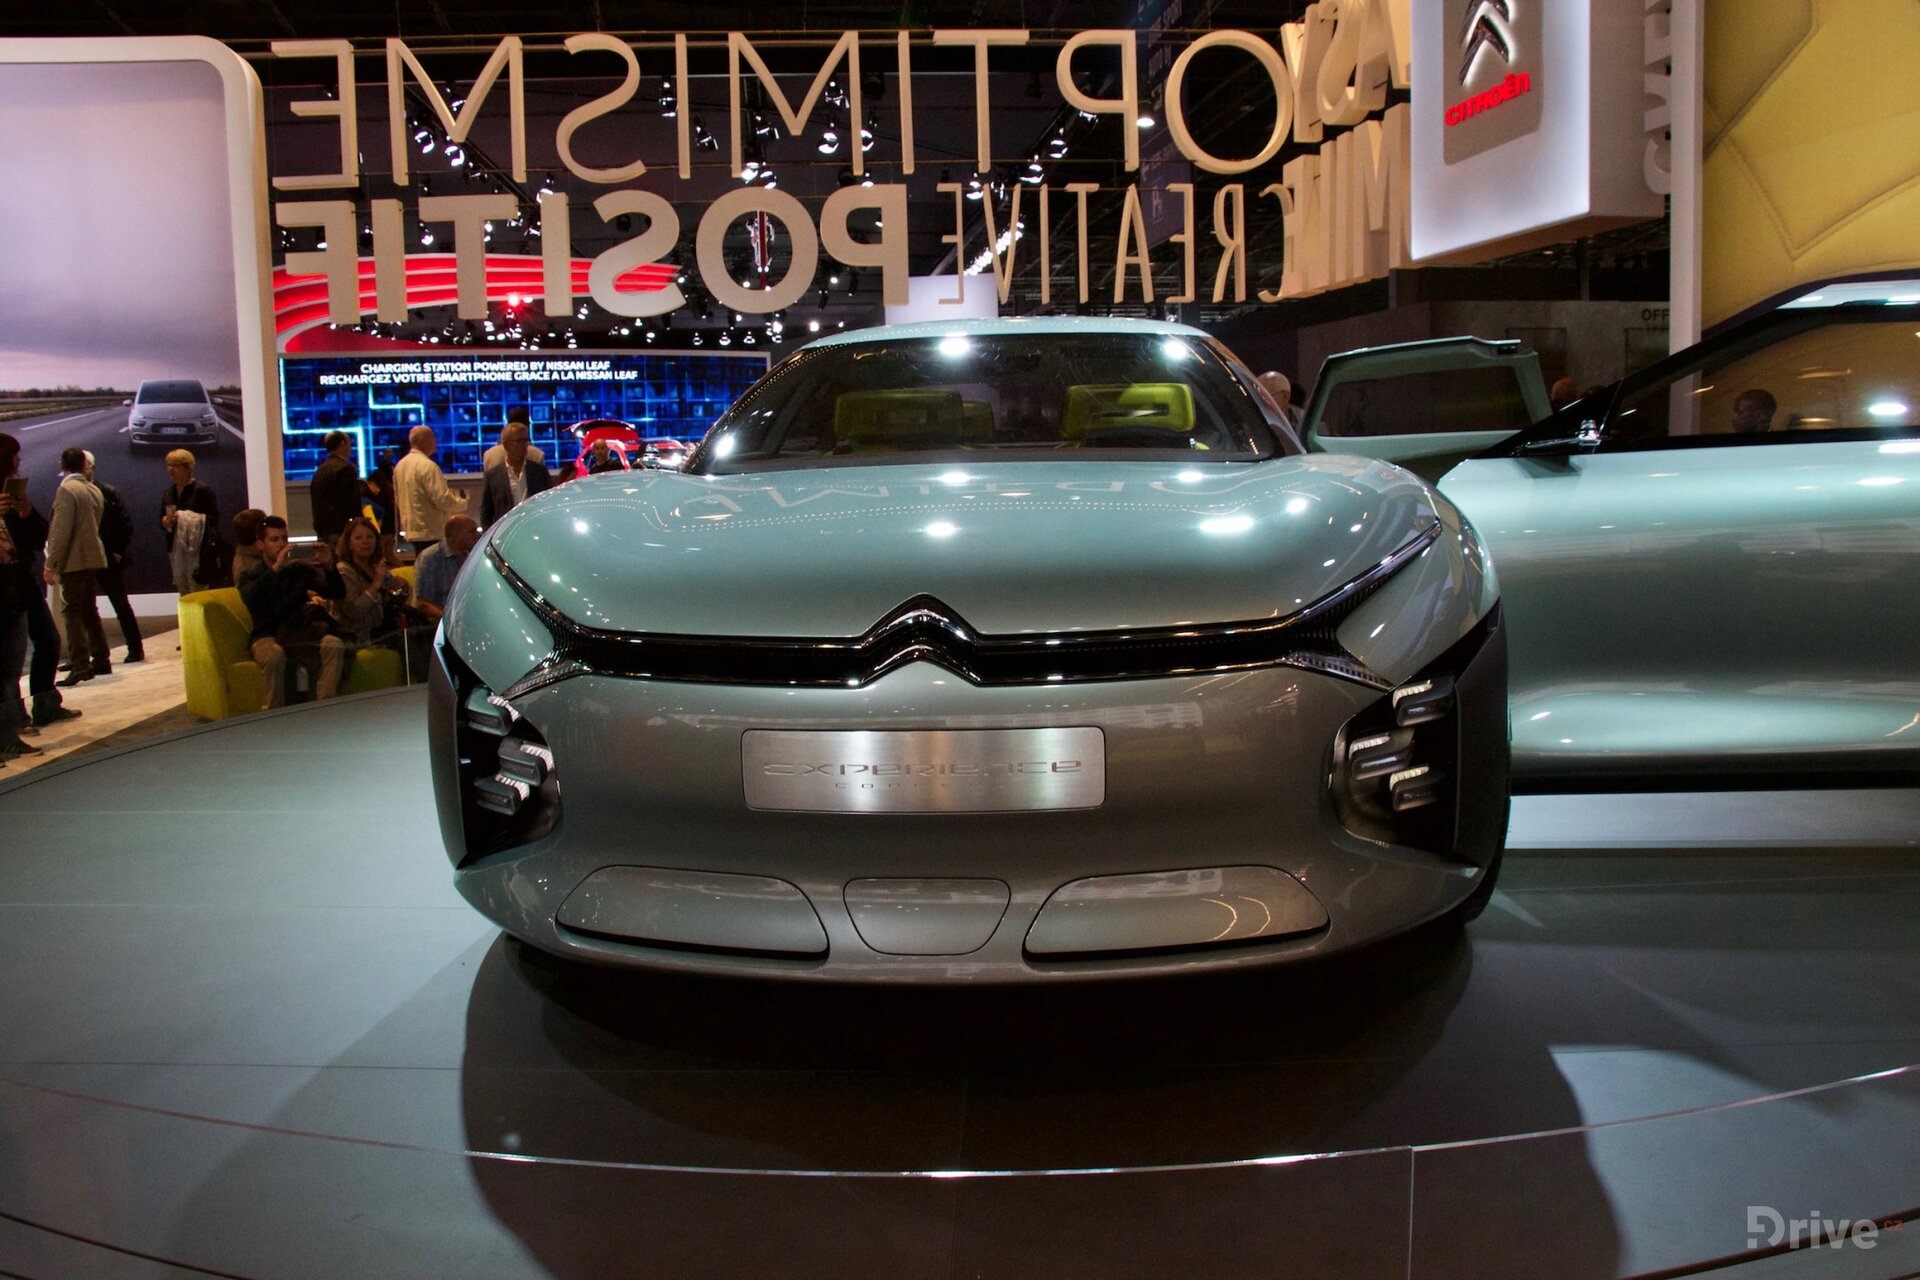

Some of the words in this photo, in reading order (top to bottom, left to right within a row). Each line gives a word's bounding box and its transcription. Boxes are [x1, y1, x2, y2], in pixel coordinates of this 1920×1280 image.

[361, 363, 421, 374] CHARGING
[423, 362, 471, 373] STATION
[473, 361, 528, 372] POWERED
[530, 361, 544, 371] BY
[546, 360, 584, 371] NISSAN
[585, 360, 611, 370] LEAF
[320, 374, 392, 385] RECHARGEZ
[393, 373, 432, 383] VOTRE
[434, 371, 513, 382] SMARTPHONE
[514, 371, 550, 381] GRACE
[551, 371, 560, 380] A
[561, 371, 575, 380] LA
[576, 370, 613, 380] NISSAN
[614, 370, 638, 380] LEAF
